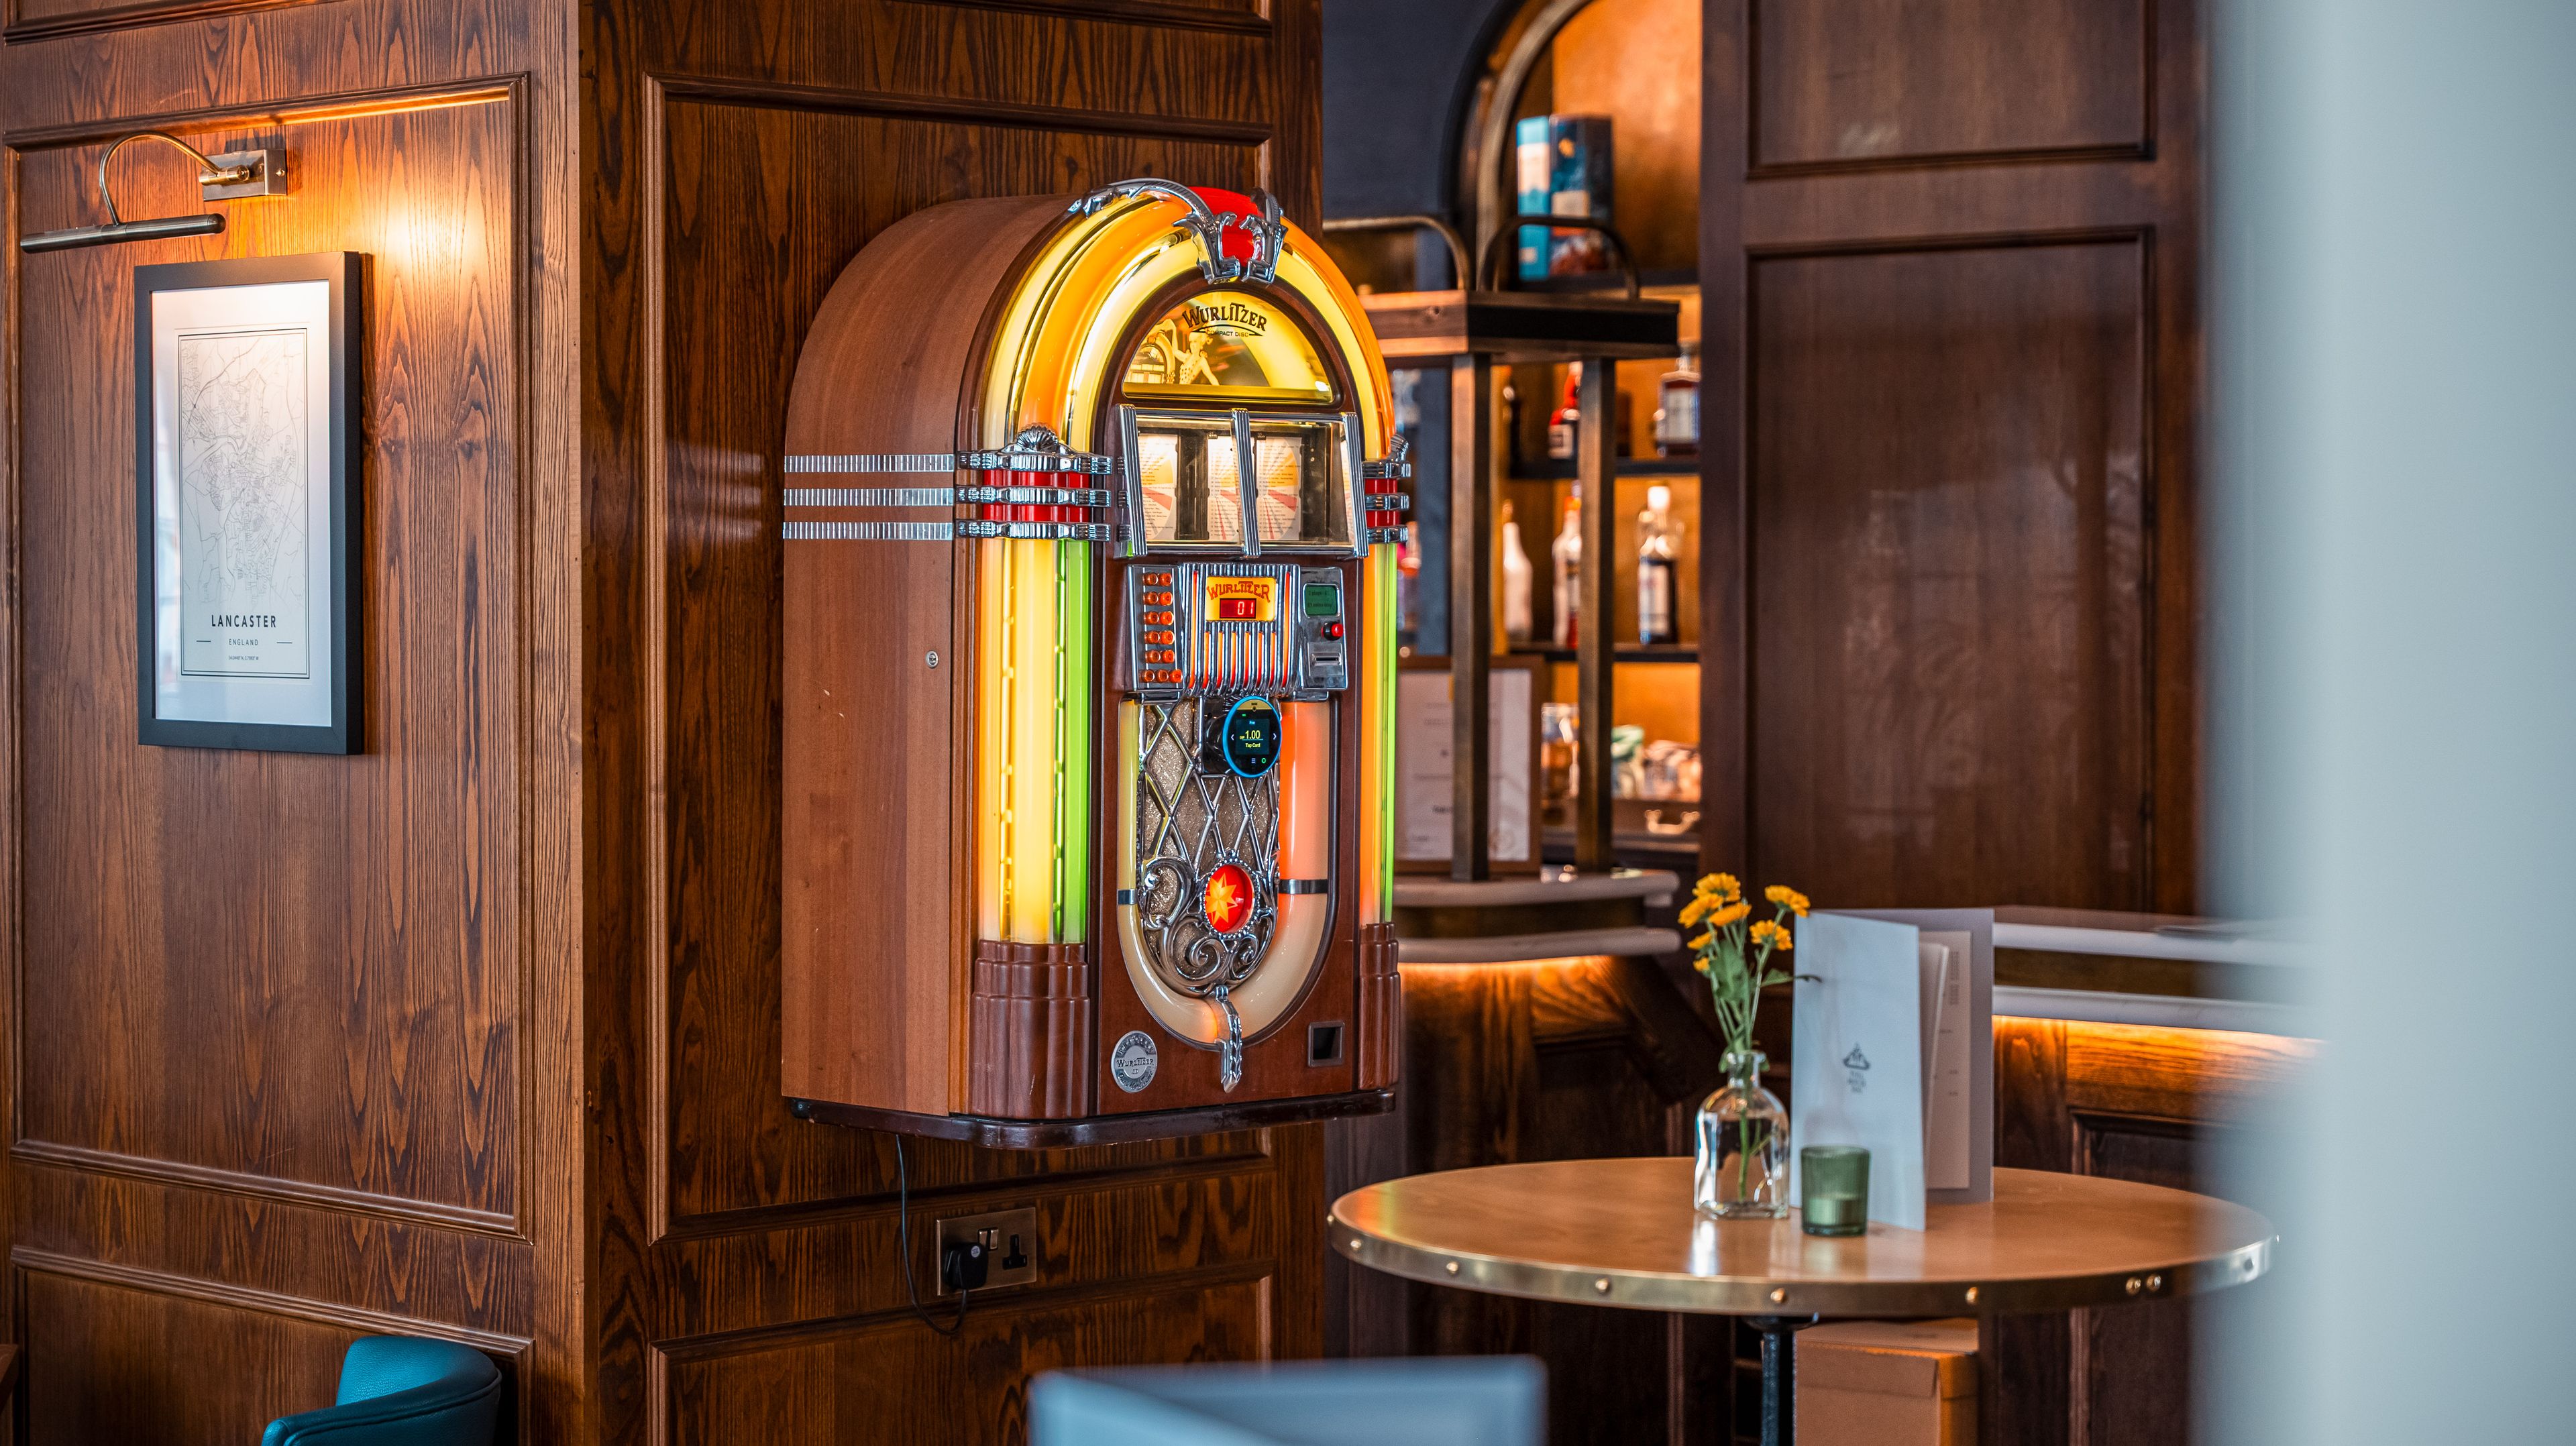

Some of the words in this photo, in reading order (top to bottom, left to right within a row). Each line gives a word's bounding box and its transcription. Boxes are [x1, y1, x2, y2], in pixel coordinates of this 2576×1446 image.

[1182, 302, 1267, 331] WURLITZER
[1206, 580, 1271, 603] WURLITZER
[1237, 601, 1254, 616] 01
[211, 614, 276, 628] LANCASTER
[1245, 730, 1260, 739] 1.00
[1117, 1057, 1154, 1068] WURLITZER
